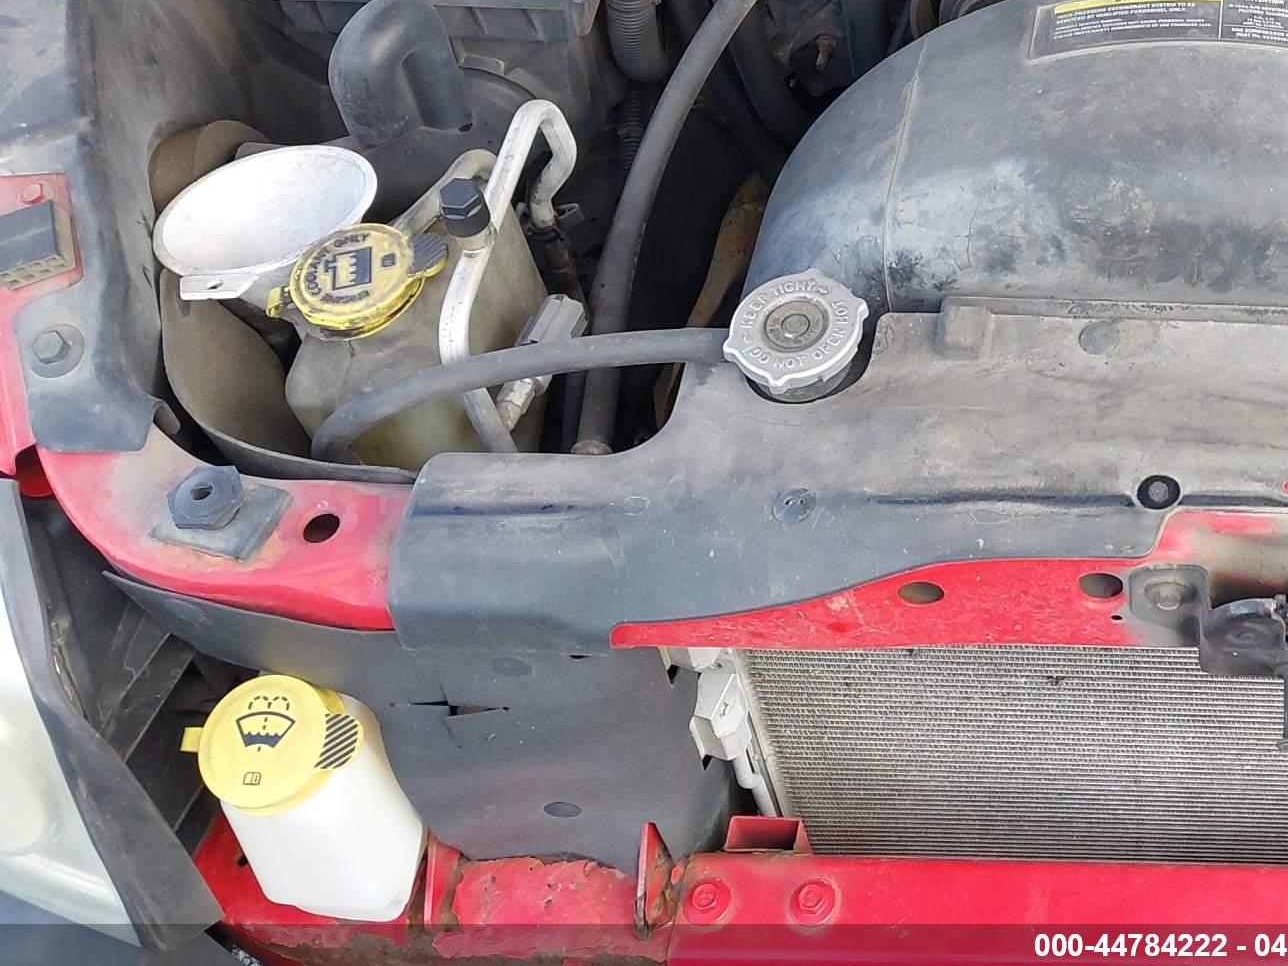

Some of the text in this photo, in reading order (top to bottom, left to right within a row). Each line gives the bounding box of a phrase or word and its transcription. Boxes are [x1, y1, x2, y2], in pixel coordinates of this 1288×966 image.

[334, 233, 369, 248] ONLY
[740, 278, 817, 329] KEEP TIGHT
[812, 328, 846, 361] OPEN
